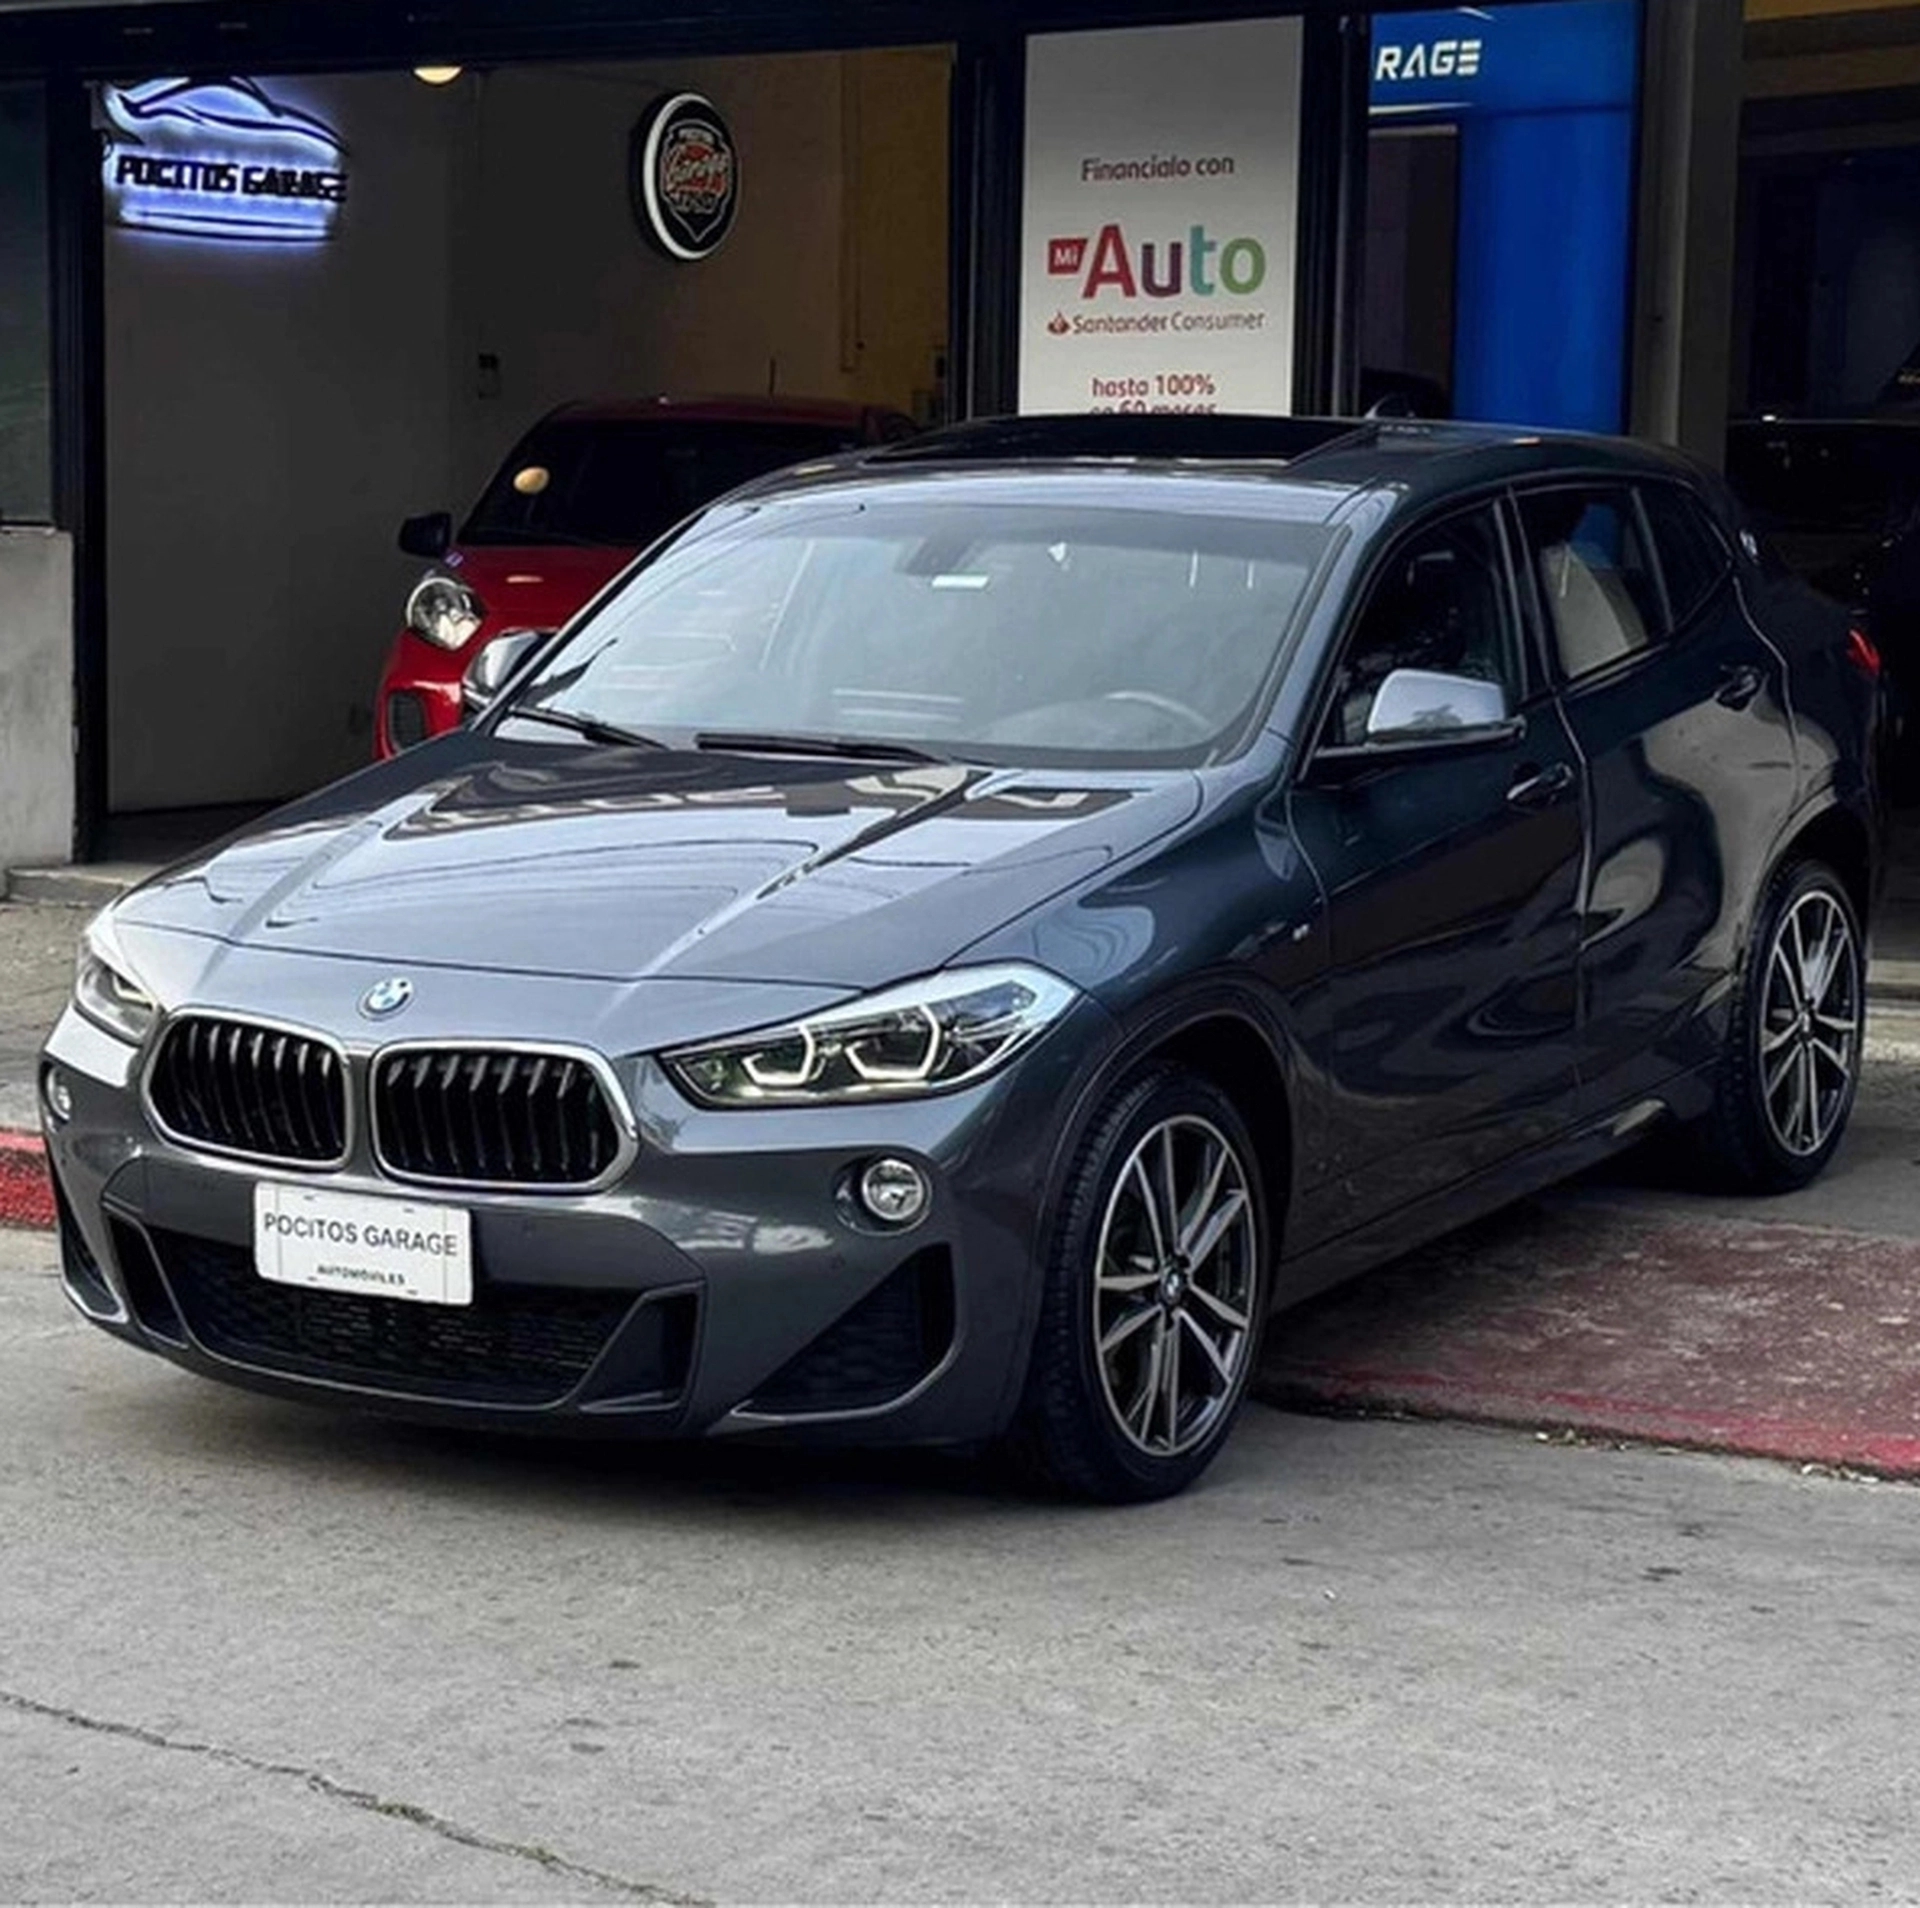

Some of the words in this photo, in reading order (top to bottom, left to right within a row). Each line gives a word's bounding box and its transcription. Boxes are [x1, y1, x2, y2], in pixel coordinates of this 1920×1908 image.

[115, 154, 240, 193] POCITOS
[1195, 156, 1235, 176] con
[1082, 223, 1267, 299] Auto
[1072, 313, 1167, 335] Santander
[1170, 311, 1266, 333] Consumer
[1092, 377, 1149, 397] hasta
[1155, 373, 1216, 395] 100%
[264, 1212, 358, 1244] POCITOS
[363, 1224, 459, 1257] GARAGE
